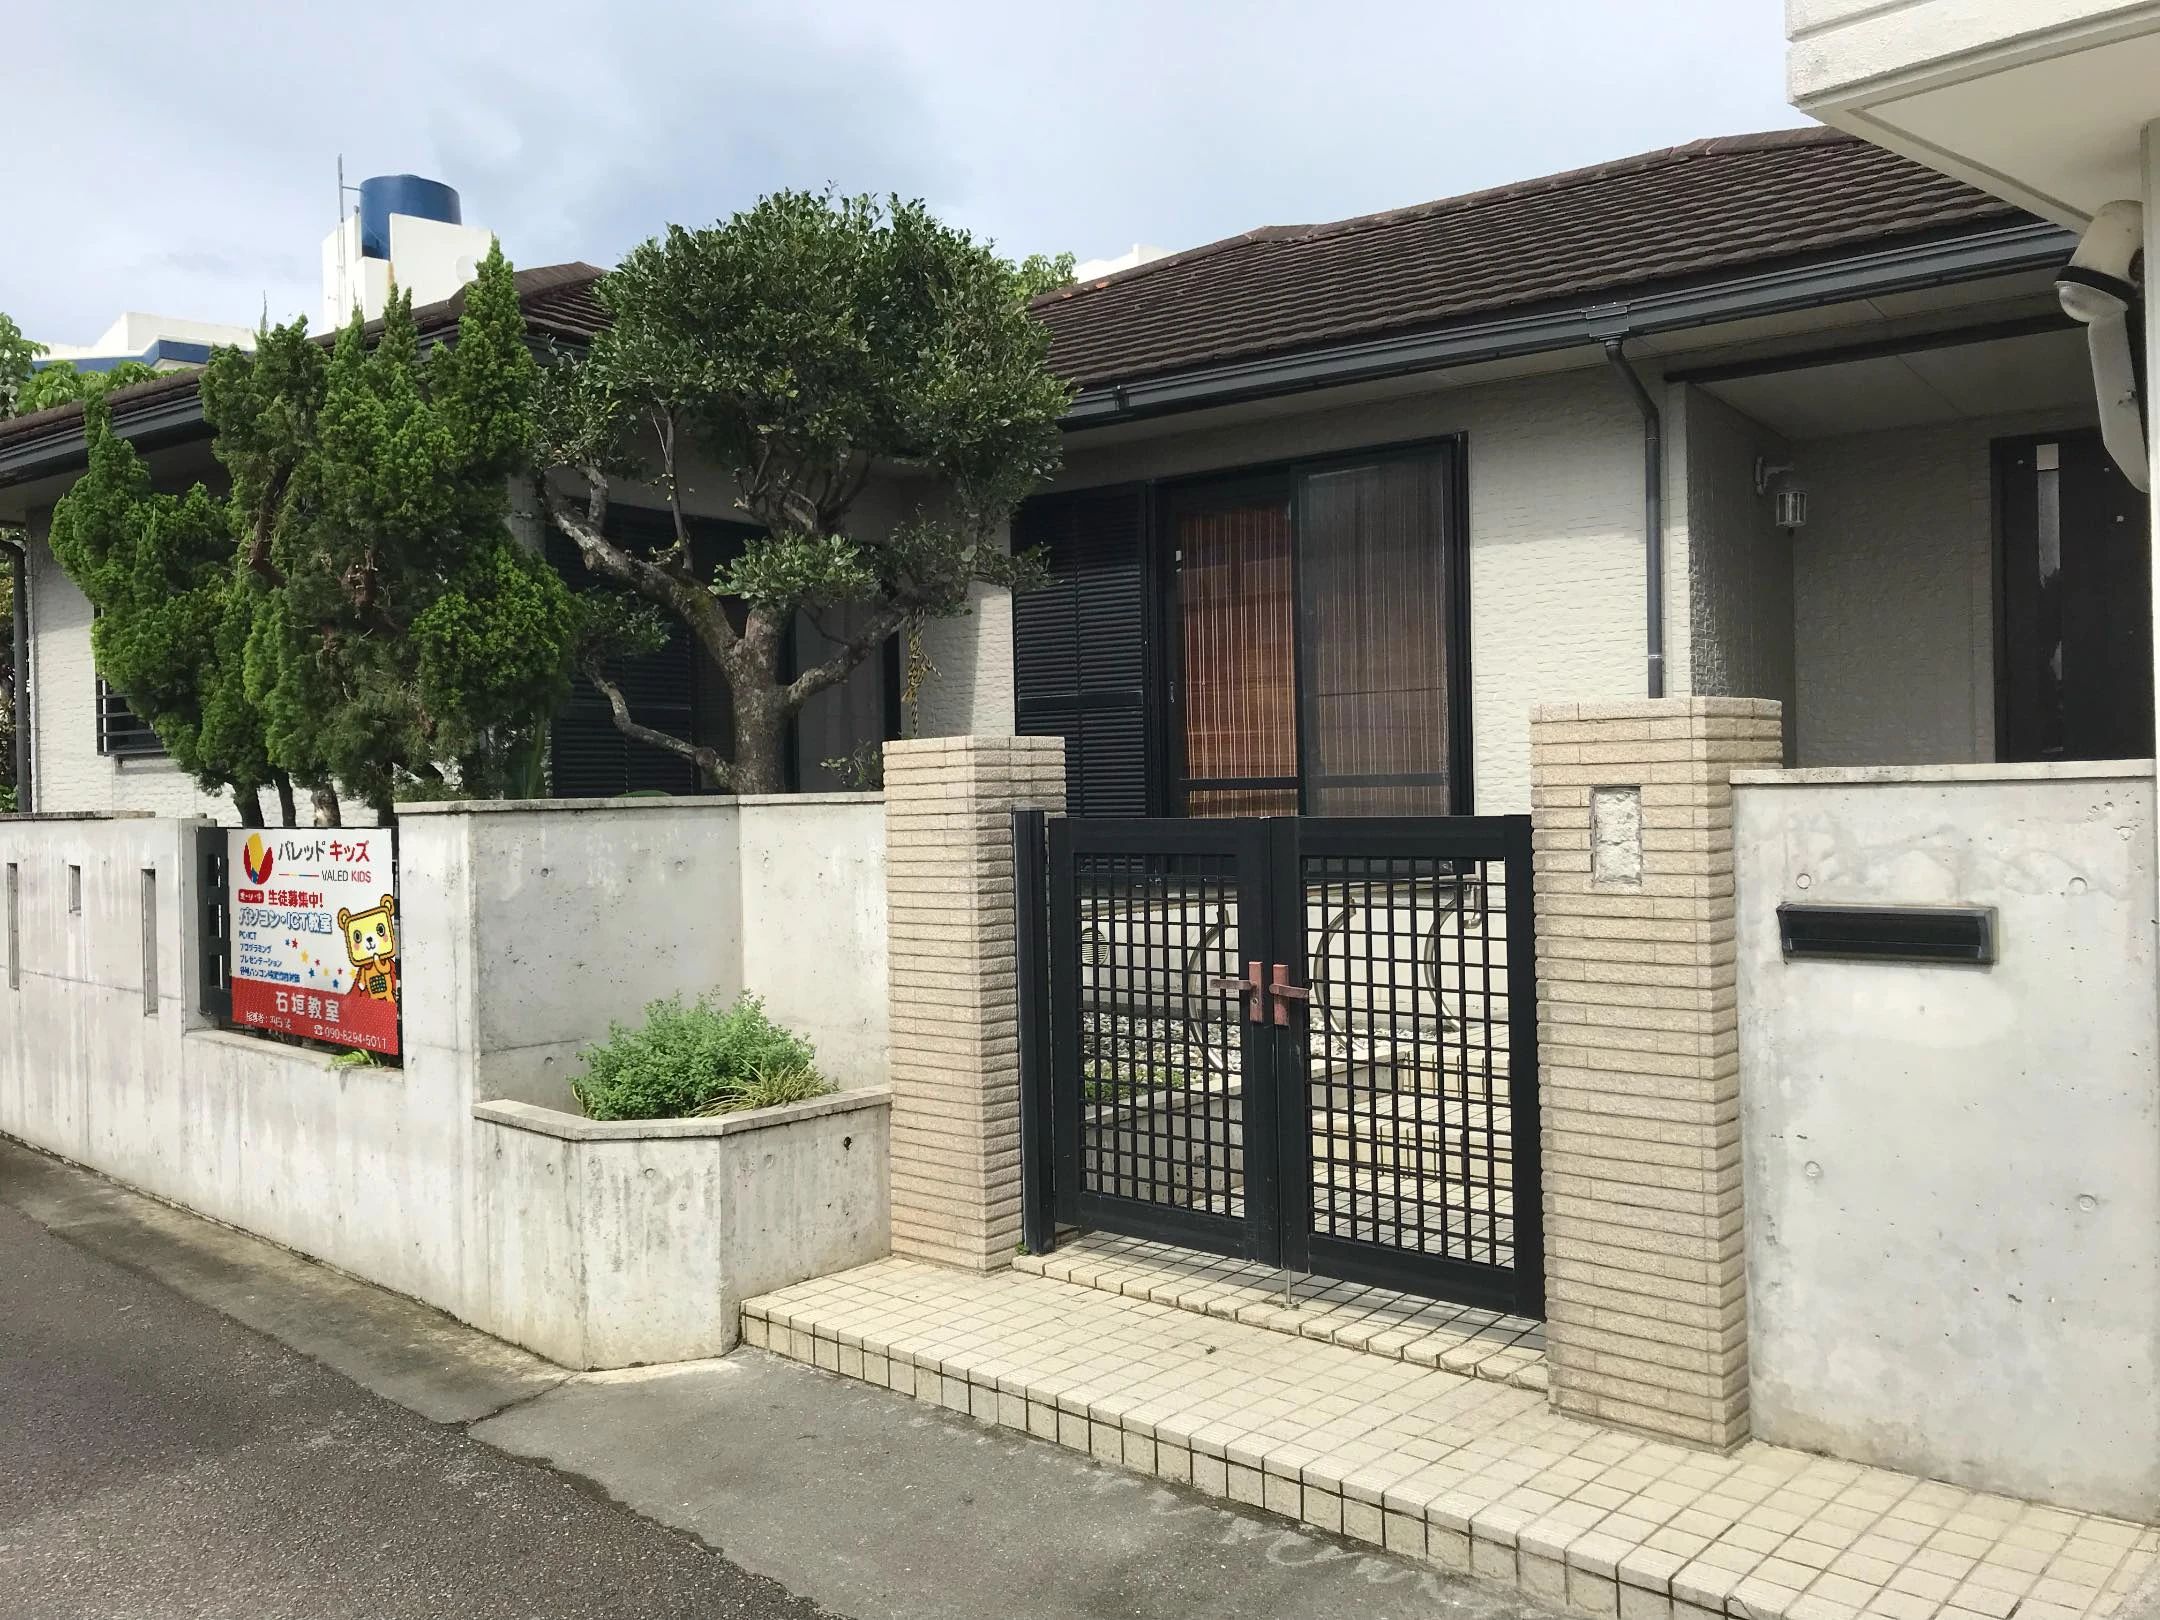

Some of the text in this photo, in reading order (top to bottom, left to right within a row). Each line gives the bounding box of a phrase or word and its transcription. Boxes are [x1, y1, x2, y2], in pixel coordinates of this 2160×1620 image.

[329, 840, 370, 863] キッズ
[321, 869, 372, 884] VALED KIDS
[275, 991, 341, 1023] 石垣教室
